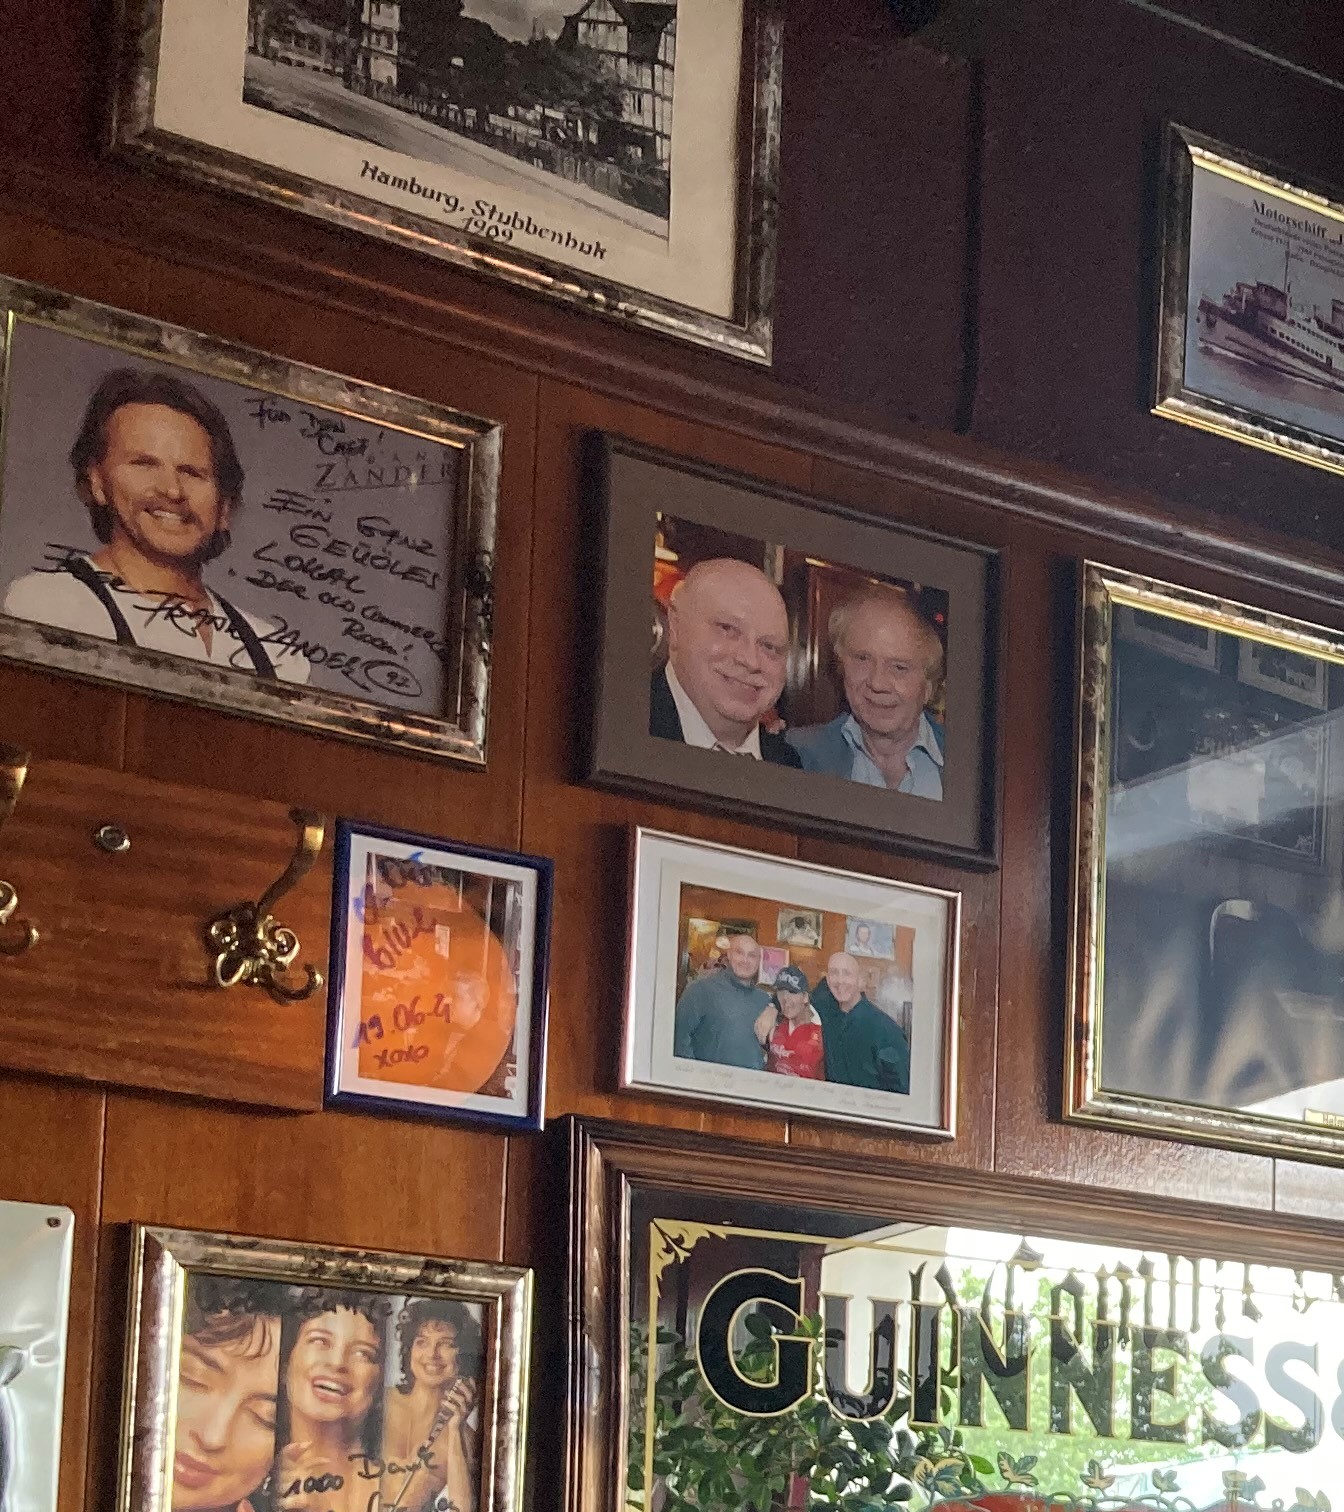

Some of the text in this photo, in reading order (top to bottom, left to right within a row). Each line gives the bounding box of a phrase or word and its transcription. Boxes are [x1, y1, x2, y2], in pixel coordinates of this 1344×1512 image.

[460, 215, 514, 243] 1909
[470, 199, 608, 260] Stubbenhuk
[1252, 199, 1328, 239] Motorschiff
[695, 1266, 1326, 1454] GUINNESS
